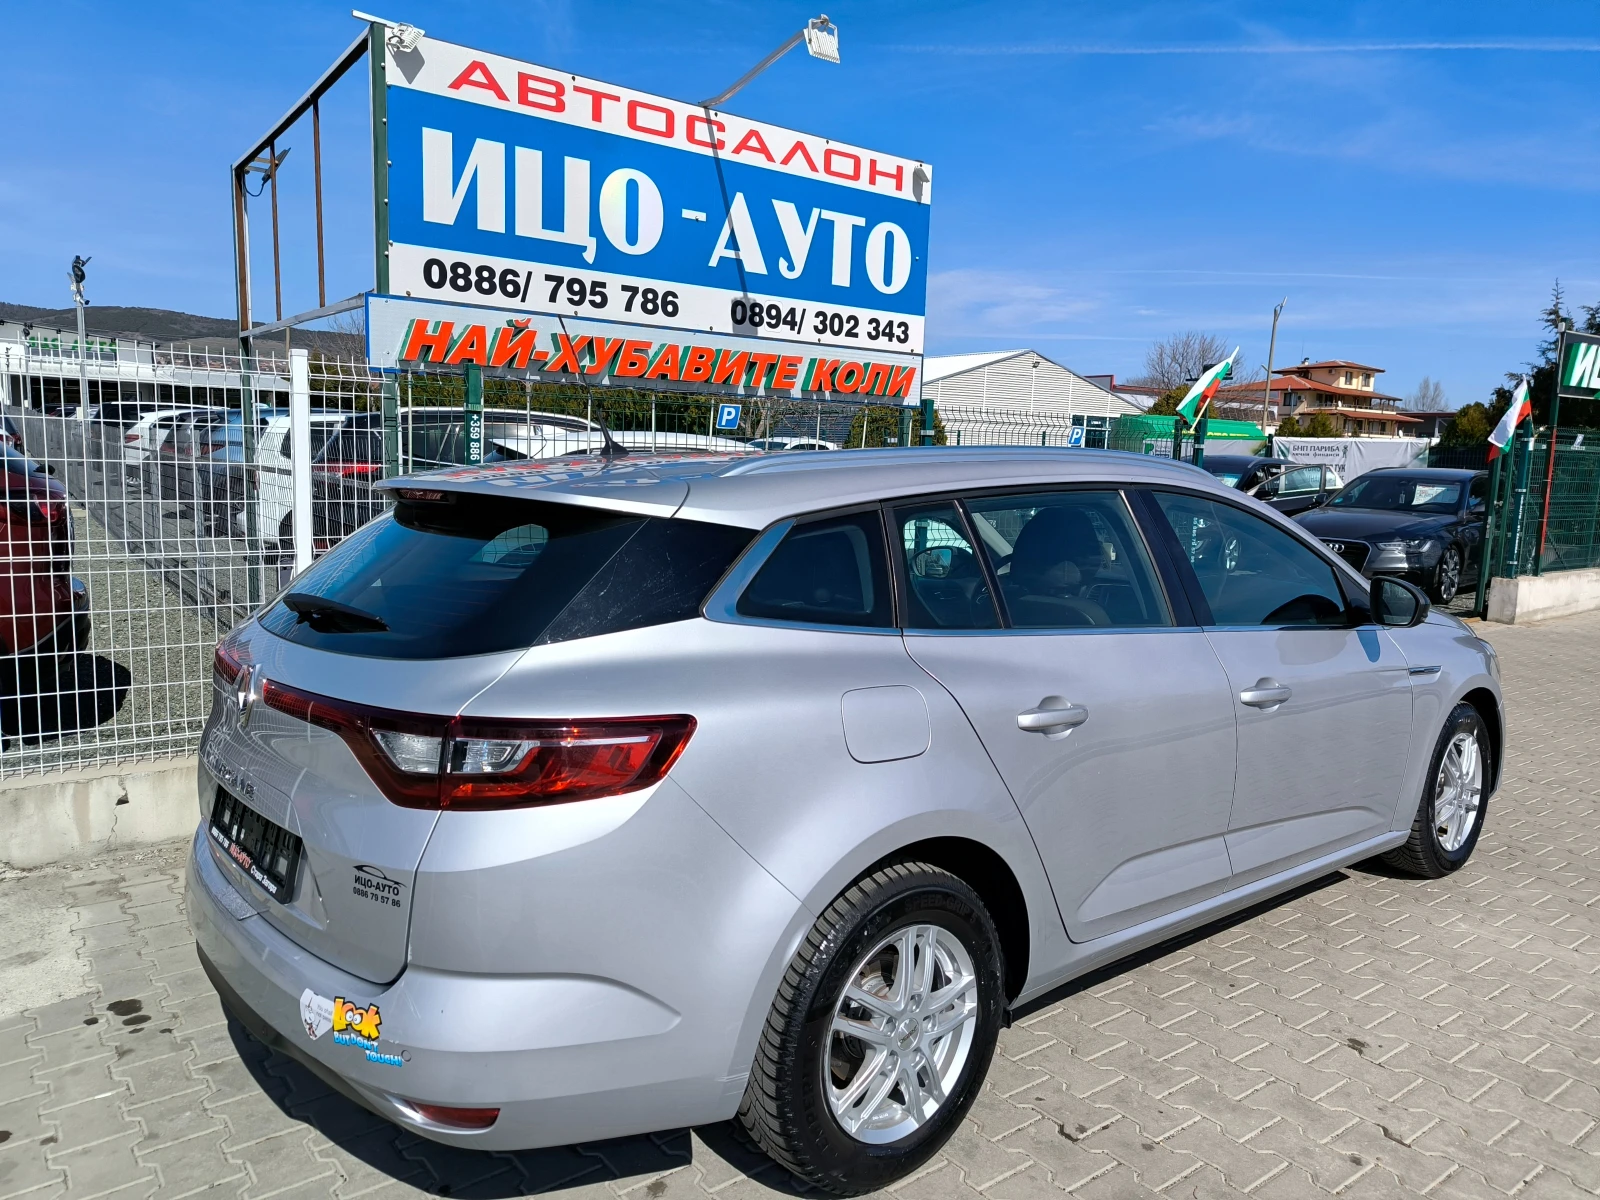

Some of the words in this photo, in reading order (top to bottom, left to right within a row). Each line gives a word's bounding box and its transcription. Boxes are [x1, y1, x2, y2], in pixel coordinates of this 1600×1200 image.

[448, 60, 903, 191] АВТОСАЛОН
[423, 258, 532, 305] 0886/
[544, 275, 608, 310] 795
[621, 284, 680, 318] 786
[730, 300, 806, 335] 0894/
[813, 310, 859, 339] 302
[867, 318, 910, 344] 343
[399, 318, 803, 390] НАЙ-ХУБАВИТЕ
[808, 357, 917, 398] КОЛИ
[470, 414, 480, 440] +359
[470, 441, 480, 461] 886
[353, 886, 369, 899] 0886
[370, 892, 379, 902] 79
[380, 895, 390, 905] 57
[391, 898, 401, 908] 86
[354, 874, 400, 896] ИЦО-АУТО
[333, 1031, 351, 1046] BUT
[365, 1050, 402, 1067] TOUCH!
